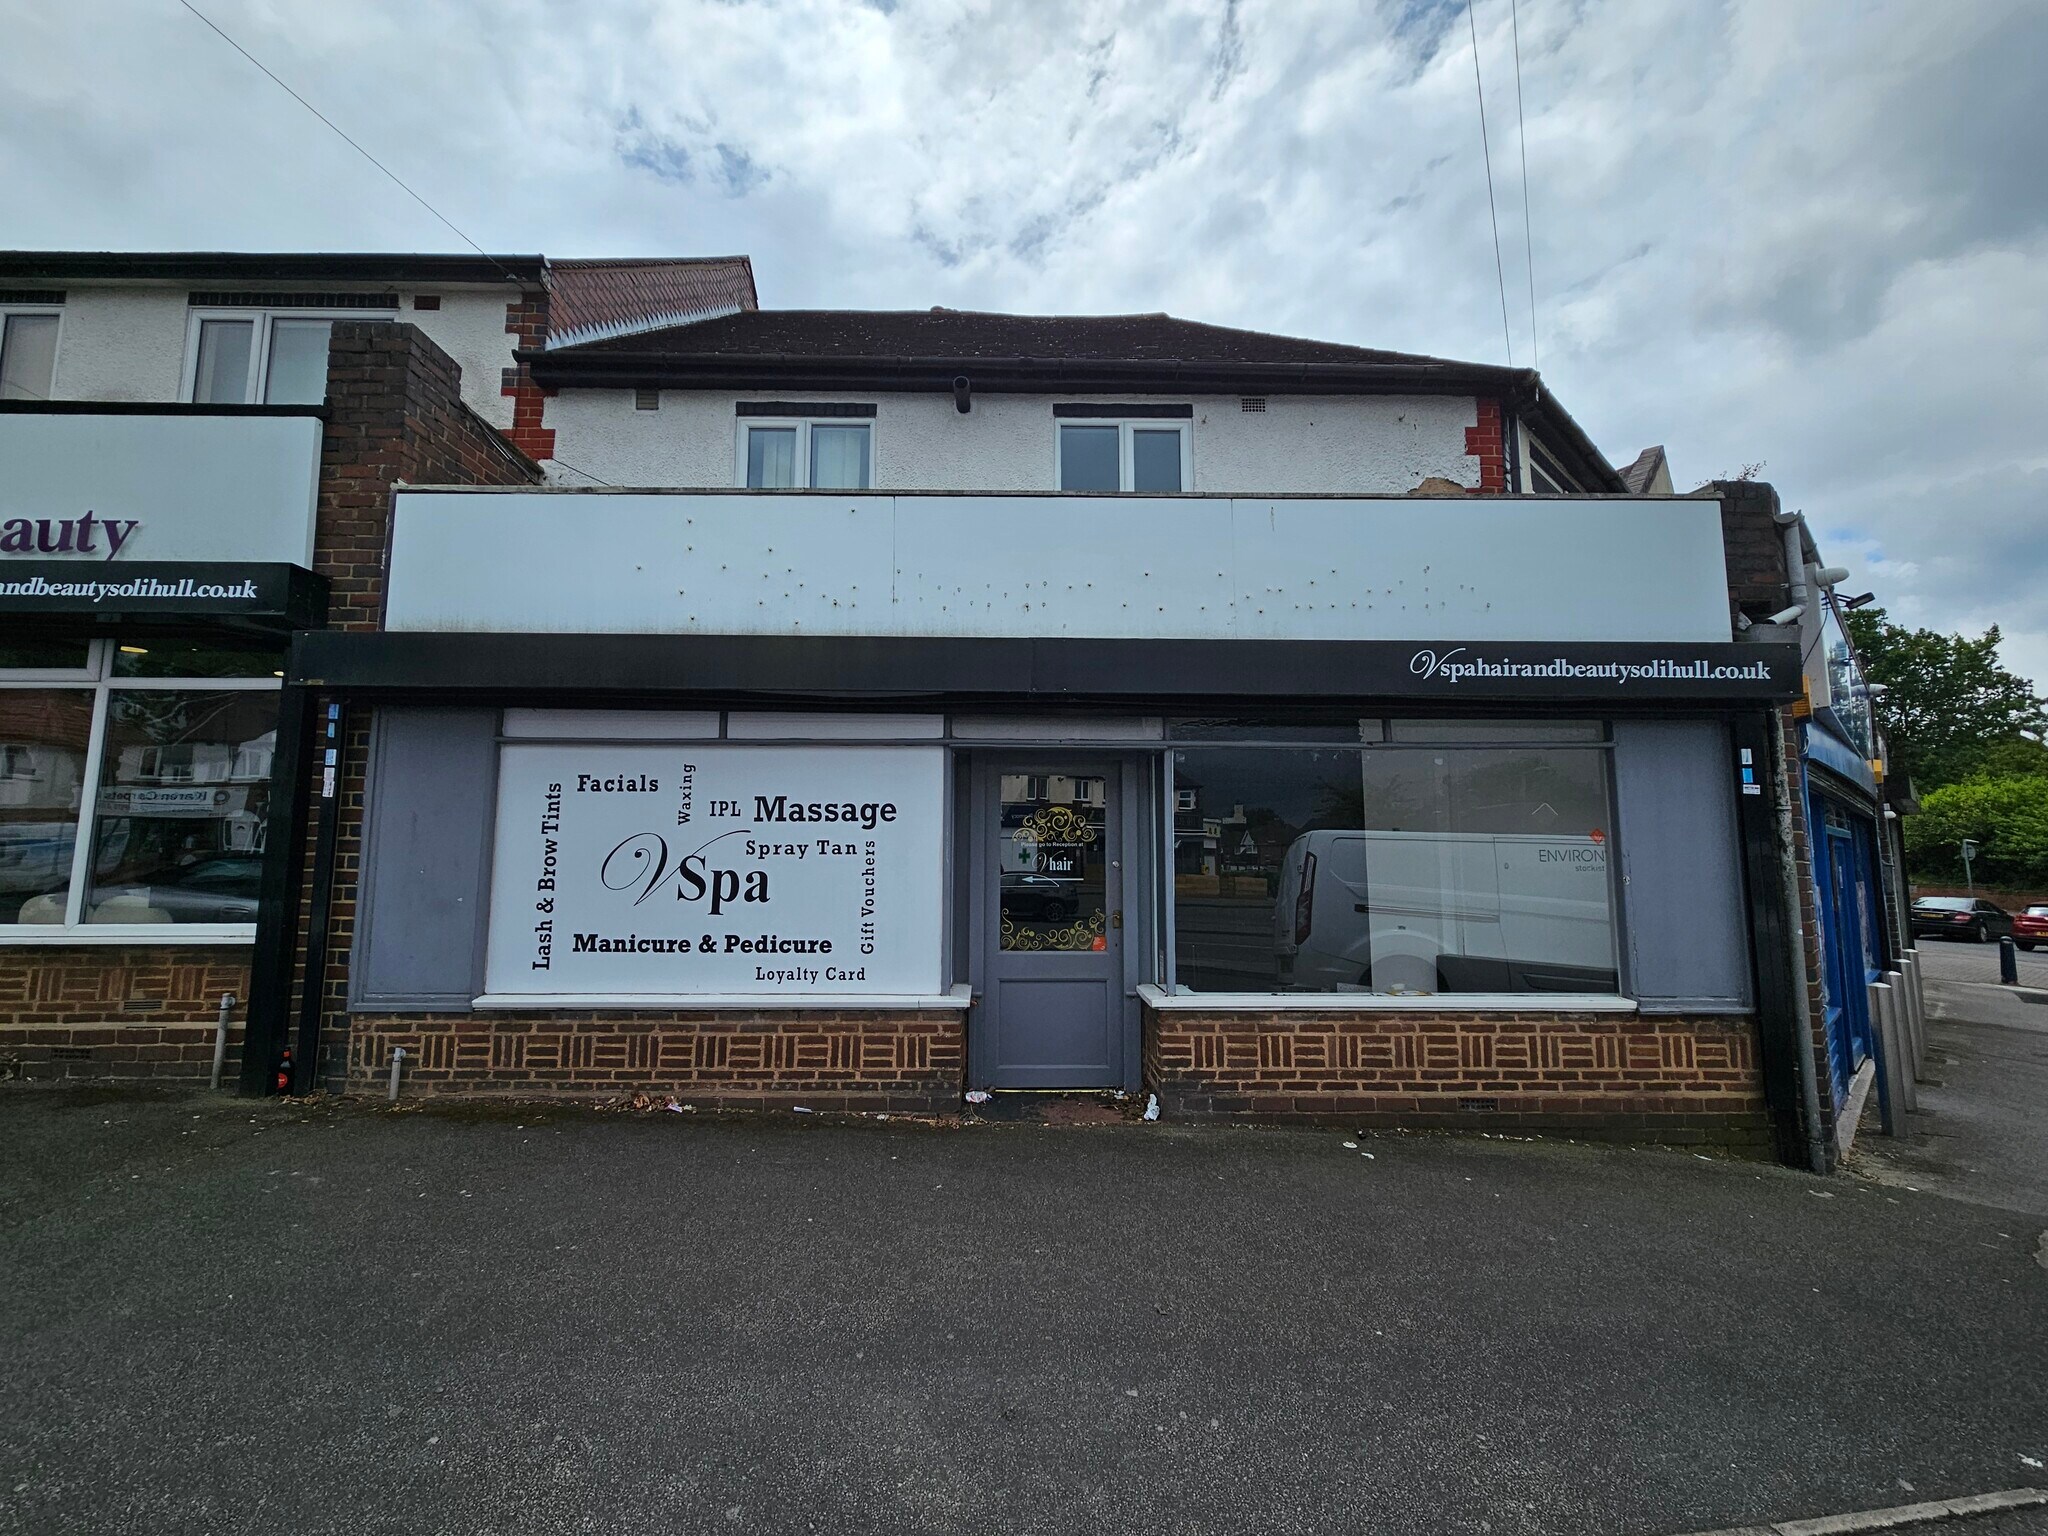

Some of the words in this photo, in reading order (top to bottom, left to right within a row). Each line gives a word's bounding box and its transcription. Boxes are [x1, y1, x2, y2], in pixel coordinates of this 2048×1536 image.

[0, 509, 139, 561] auty
[1409, 647, 1771, 684] Vspahairandbeautysolihull.co.uk
[576, 773, 659, 793] Facials
[677, 763, 697, 826] Waxing
[540, 782, 562, 835] Tints
[709, 800, 741, 817] IPL
[753, 795, 897, 830] Massage
[537, 837, 558, 892] Brow
[745, 839, 809, 860] Spray
[816, 839, 858, 856] Tan
[1538, 849, 1606, 863] ENVIRON
[860, 840, 876, 919] Vouchers
[1575, 865, 1606, 873] stockist
[535, 897, 555, 914] &
[531, 919, 553, 971] Lash
[572, 933, 692, 954] Manicure
[698, 934, 718, 954] &
[723, 934, 833, 954] Pedicure
[860, 922, 876, 955] Gift
[755, 966, 819, 985] Loyalty
[825, 966, 866, 981] Card
